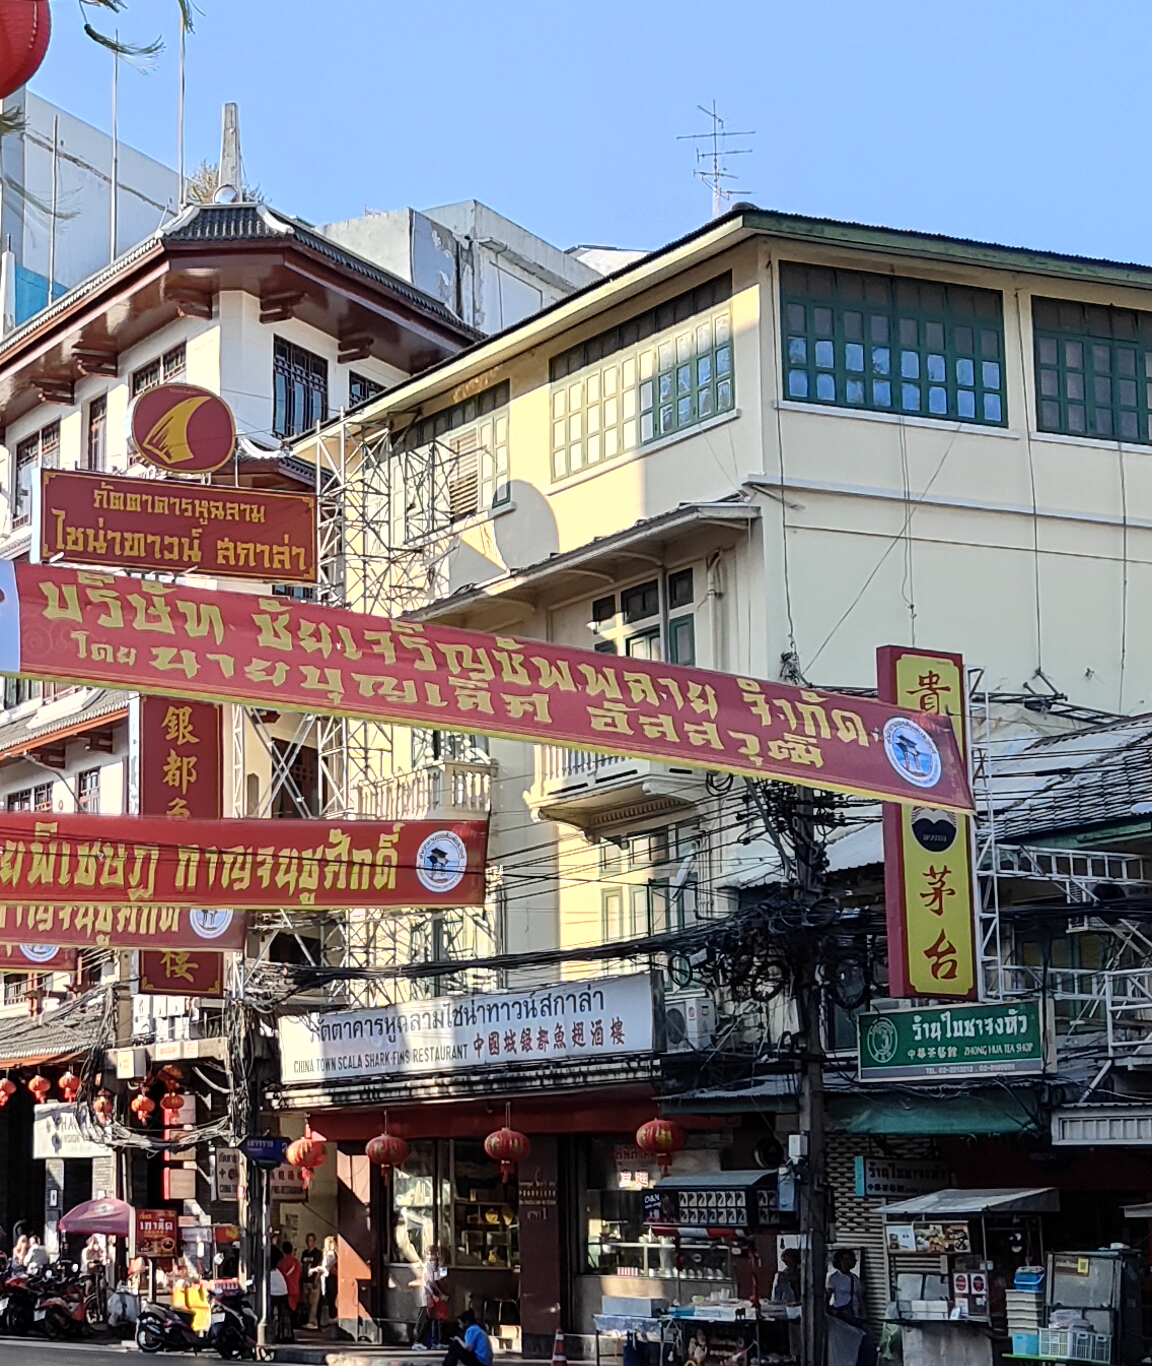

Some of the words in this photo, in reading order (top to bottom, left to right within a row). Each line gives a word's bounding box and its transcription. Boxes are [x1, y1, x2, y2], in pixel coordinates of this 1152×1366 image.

[93, 482, 266, 525] ภัตตาคารหูฉลาม
[51, 508, 203, 563] ไชน่าทาวน์
[216, 534, 307, 571] สกาล่า
[38, 570, 226, 645] บริษัท
[737, 677, 870, 747] จำกัด
[68, 630, 138, 666] โดย
[337, 1054, 363, 1071] SCALA
[413, 1043, 469, 1063] RESTAURANT
